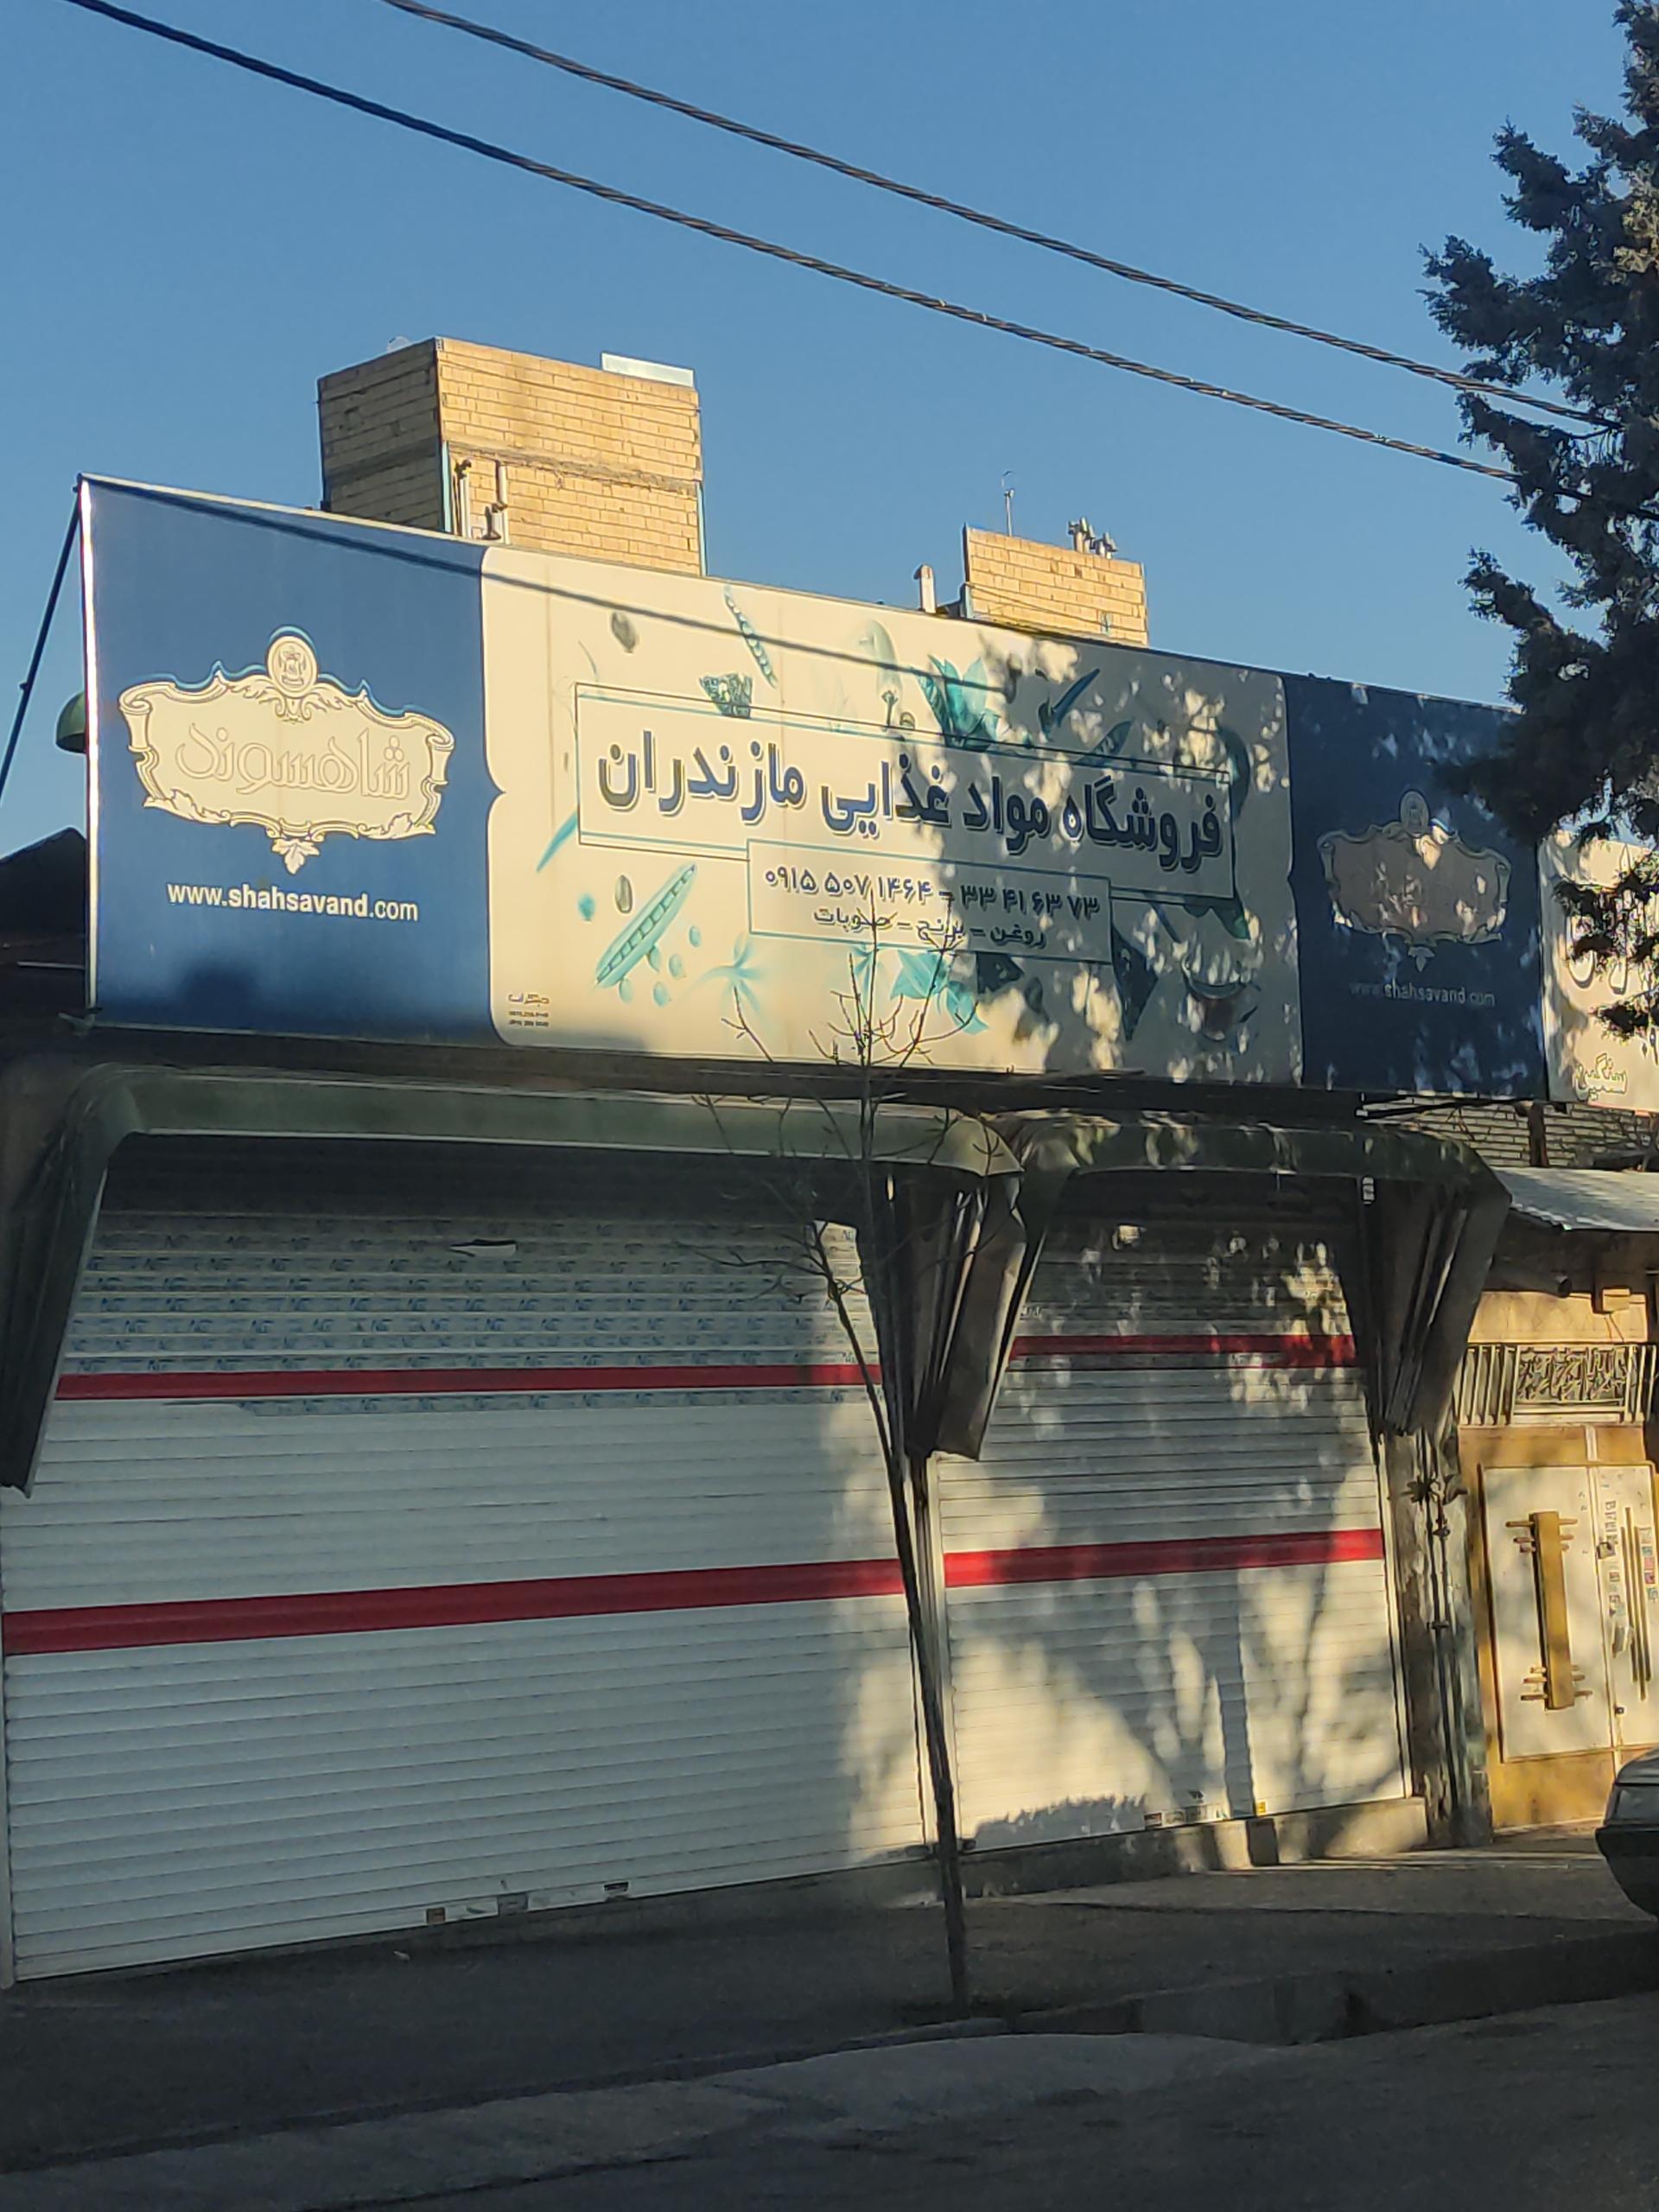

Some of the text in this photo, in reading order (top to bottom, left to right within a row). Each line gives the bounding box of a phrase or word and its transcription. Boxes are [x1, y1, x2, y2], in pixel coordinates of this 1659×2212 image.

[175, 722, 412, 800] شاهسوند
[598, 729, 1223, 870] فروشگاه مواد غذایی مازندران
[167, 883, 419, 922] www.shahsavand.com
[766, 866, 817, 892] ۰۹۱۵
[824, 871, 869, 896] ۵۰۷
[878, 875, 931, 901] ۱۴۶۴
[960, 885, 995, 908] ۳۳
[1001, 888, 1025, 912] ۴۱
[1032, 891, 1061, 915] ۶۳
[1066, 894, 1099, 920] ۷۳
[916, 918, 964, 946] برنج
[989, 924, 1046, 948] روغن
